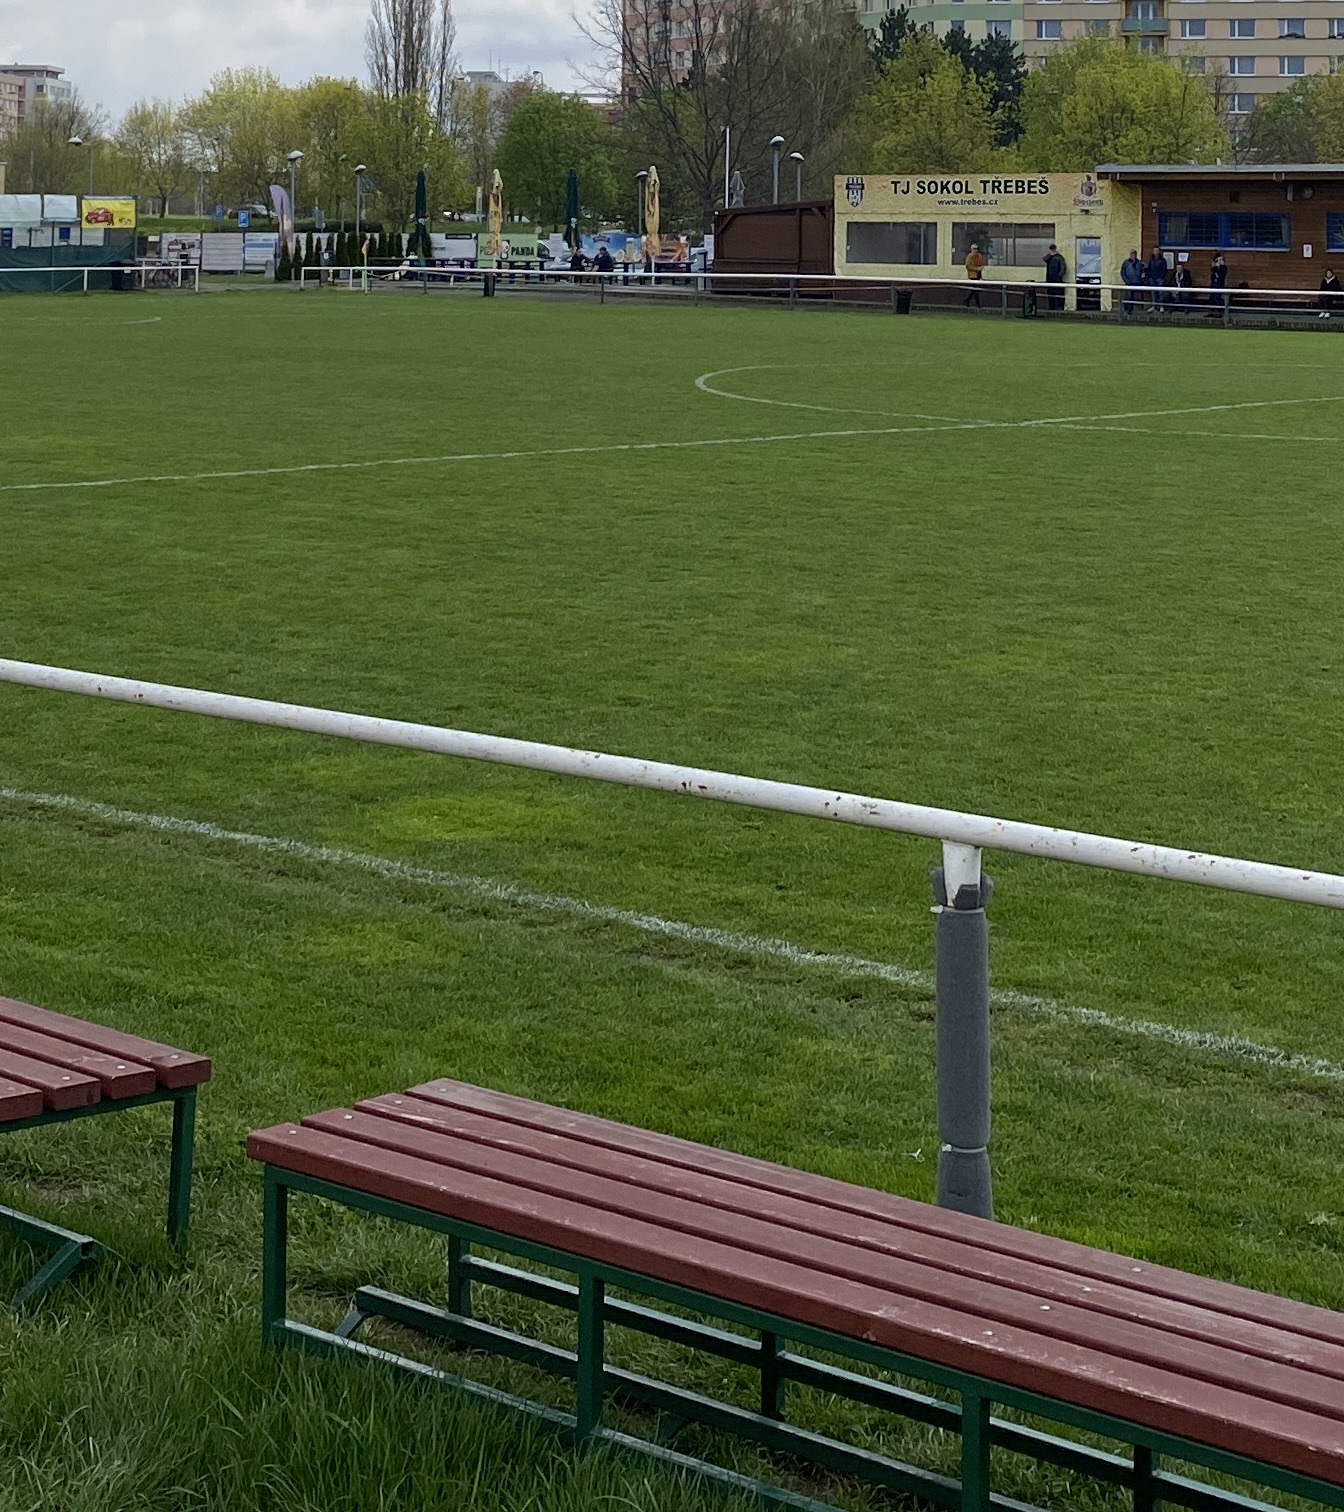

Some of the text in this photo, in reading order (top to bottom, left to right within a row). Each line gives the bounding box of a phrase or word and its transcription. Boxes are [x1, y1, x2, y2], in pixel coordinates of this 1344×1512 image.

[890, 175, 1049, 195] TJ SOKOL TŘEBEŠ
